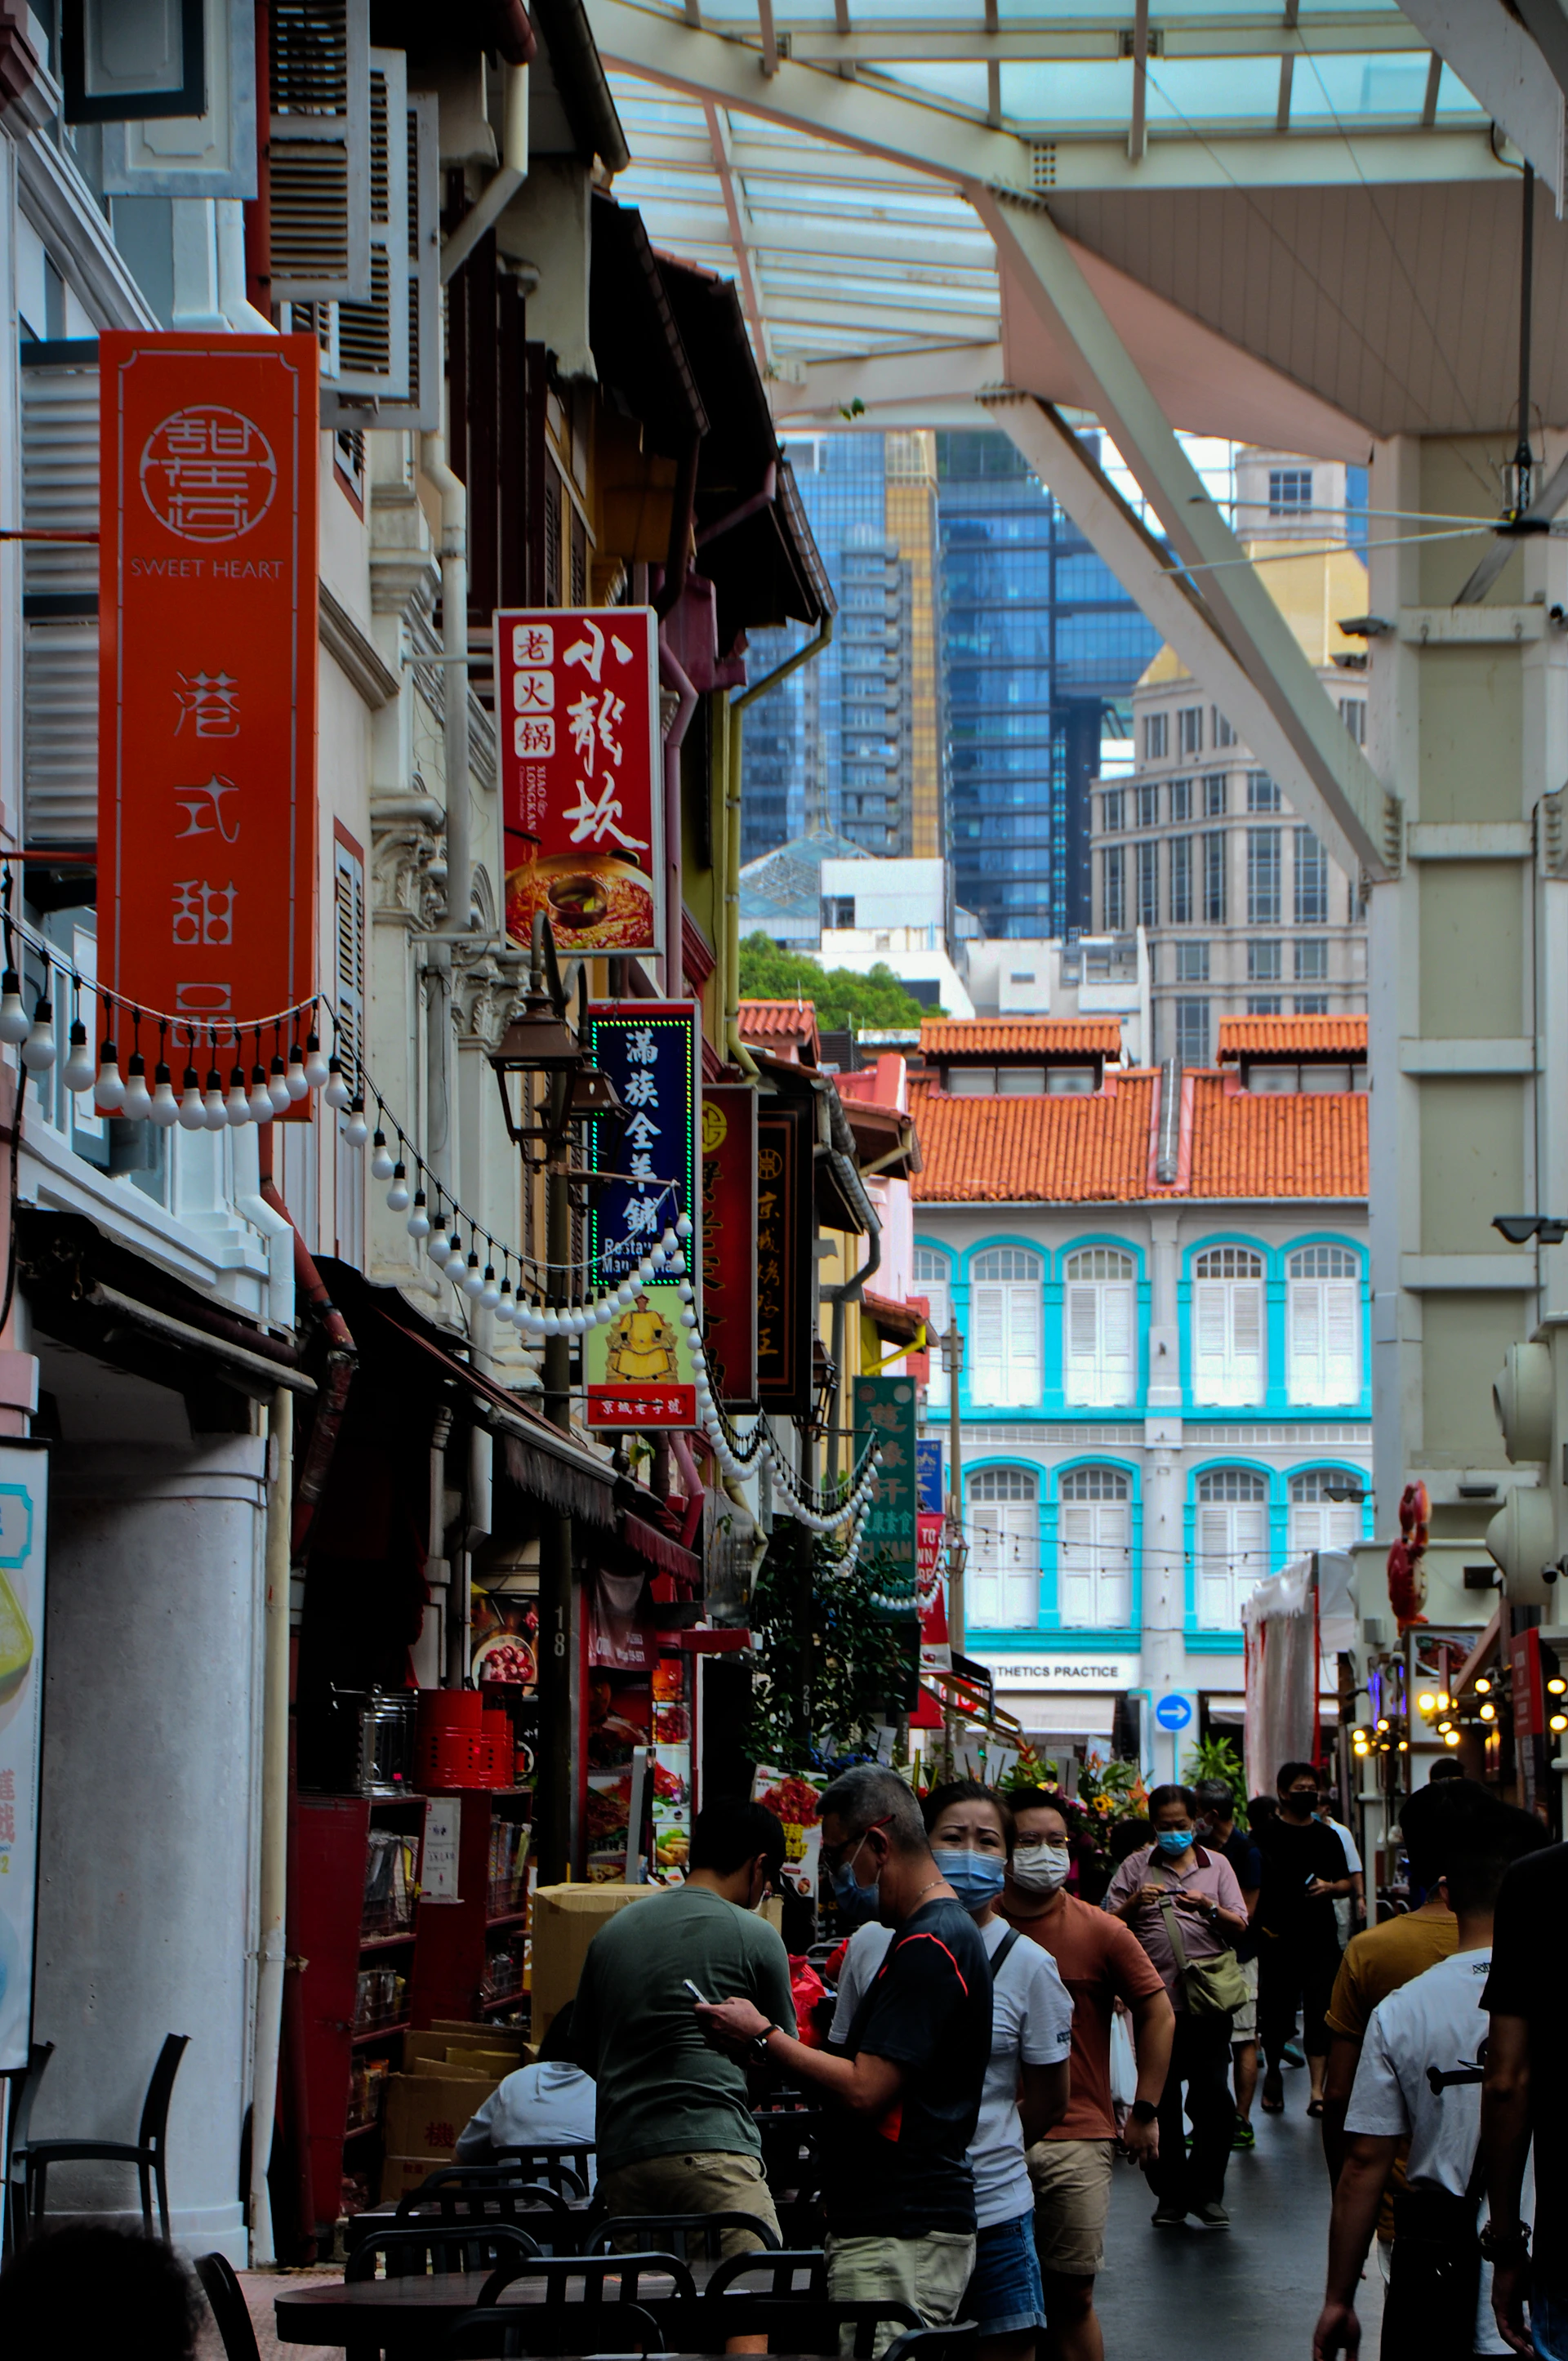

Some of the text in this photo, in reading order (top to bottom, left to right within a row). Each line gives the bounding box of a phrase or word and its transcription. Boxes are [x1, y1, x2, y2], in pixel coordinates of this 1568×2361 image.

[130, 558, 284, 579] SWEET HEART
[517, 629, 553, 755] 老火锅
[526, 765, 537, 831] LONGKAN
[537, 764, 547, 799] XIAO
[172, 670, 240, 1049] 港式甜品
[1054, 1666, 1119, 1677] PRACTICE
